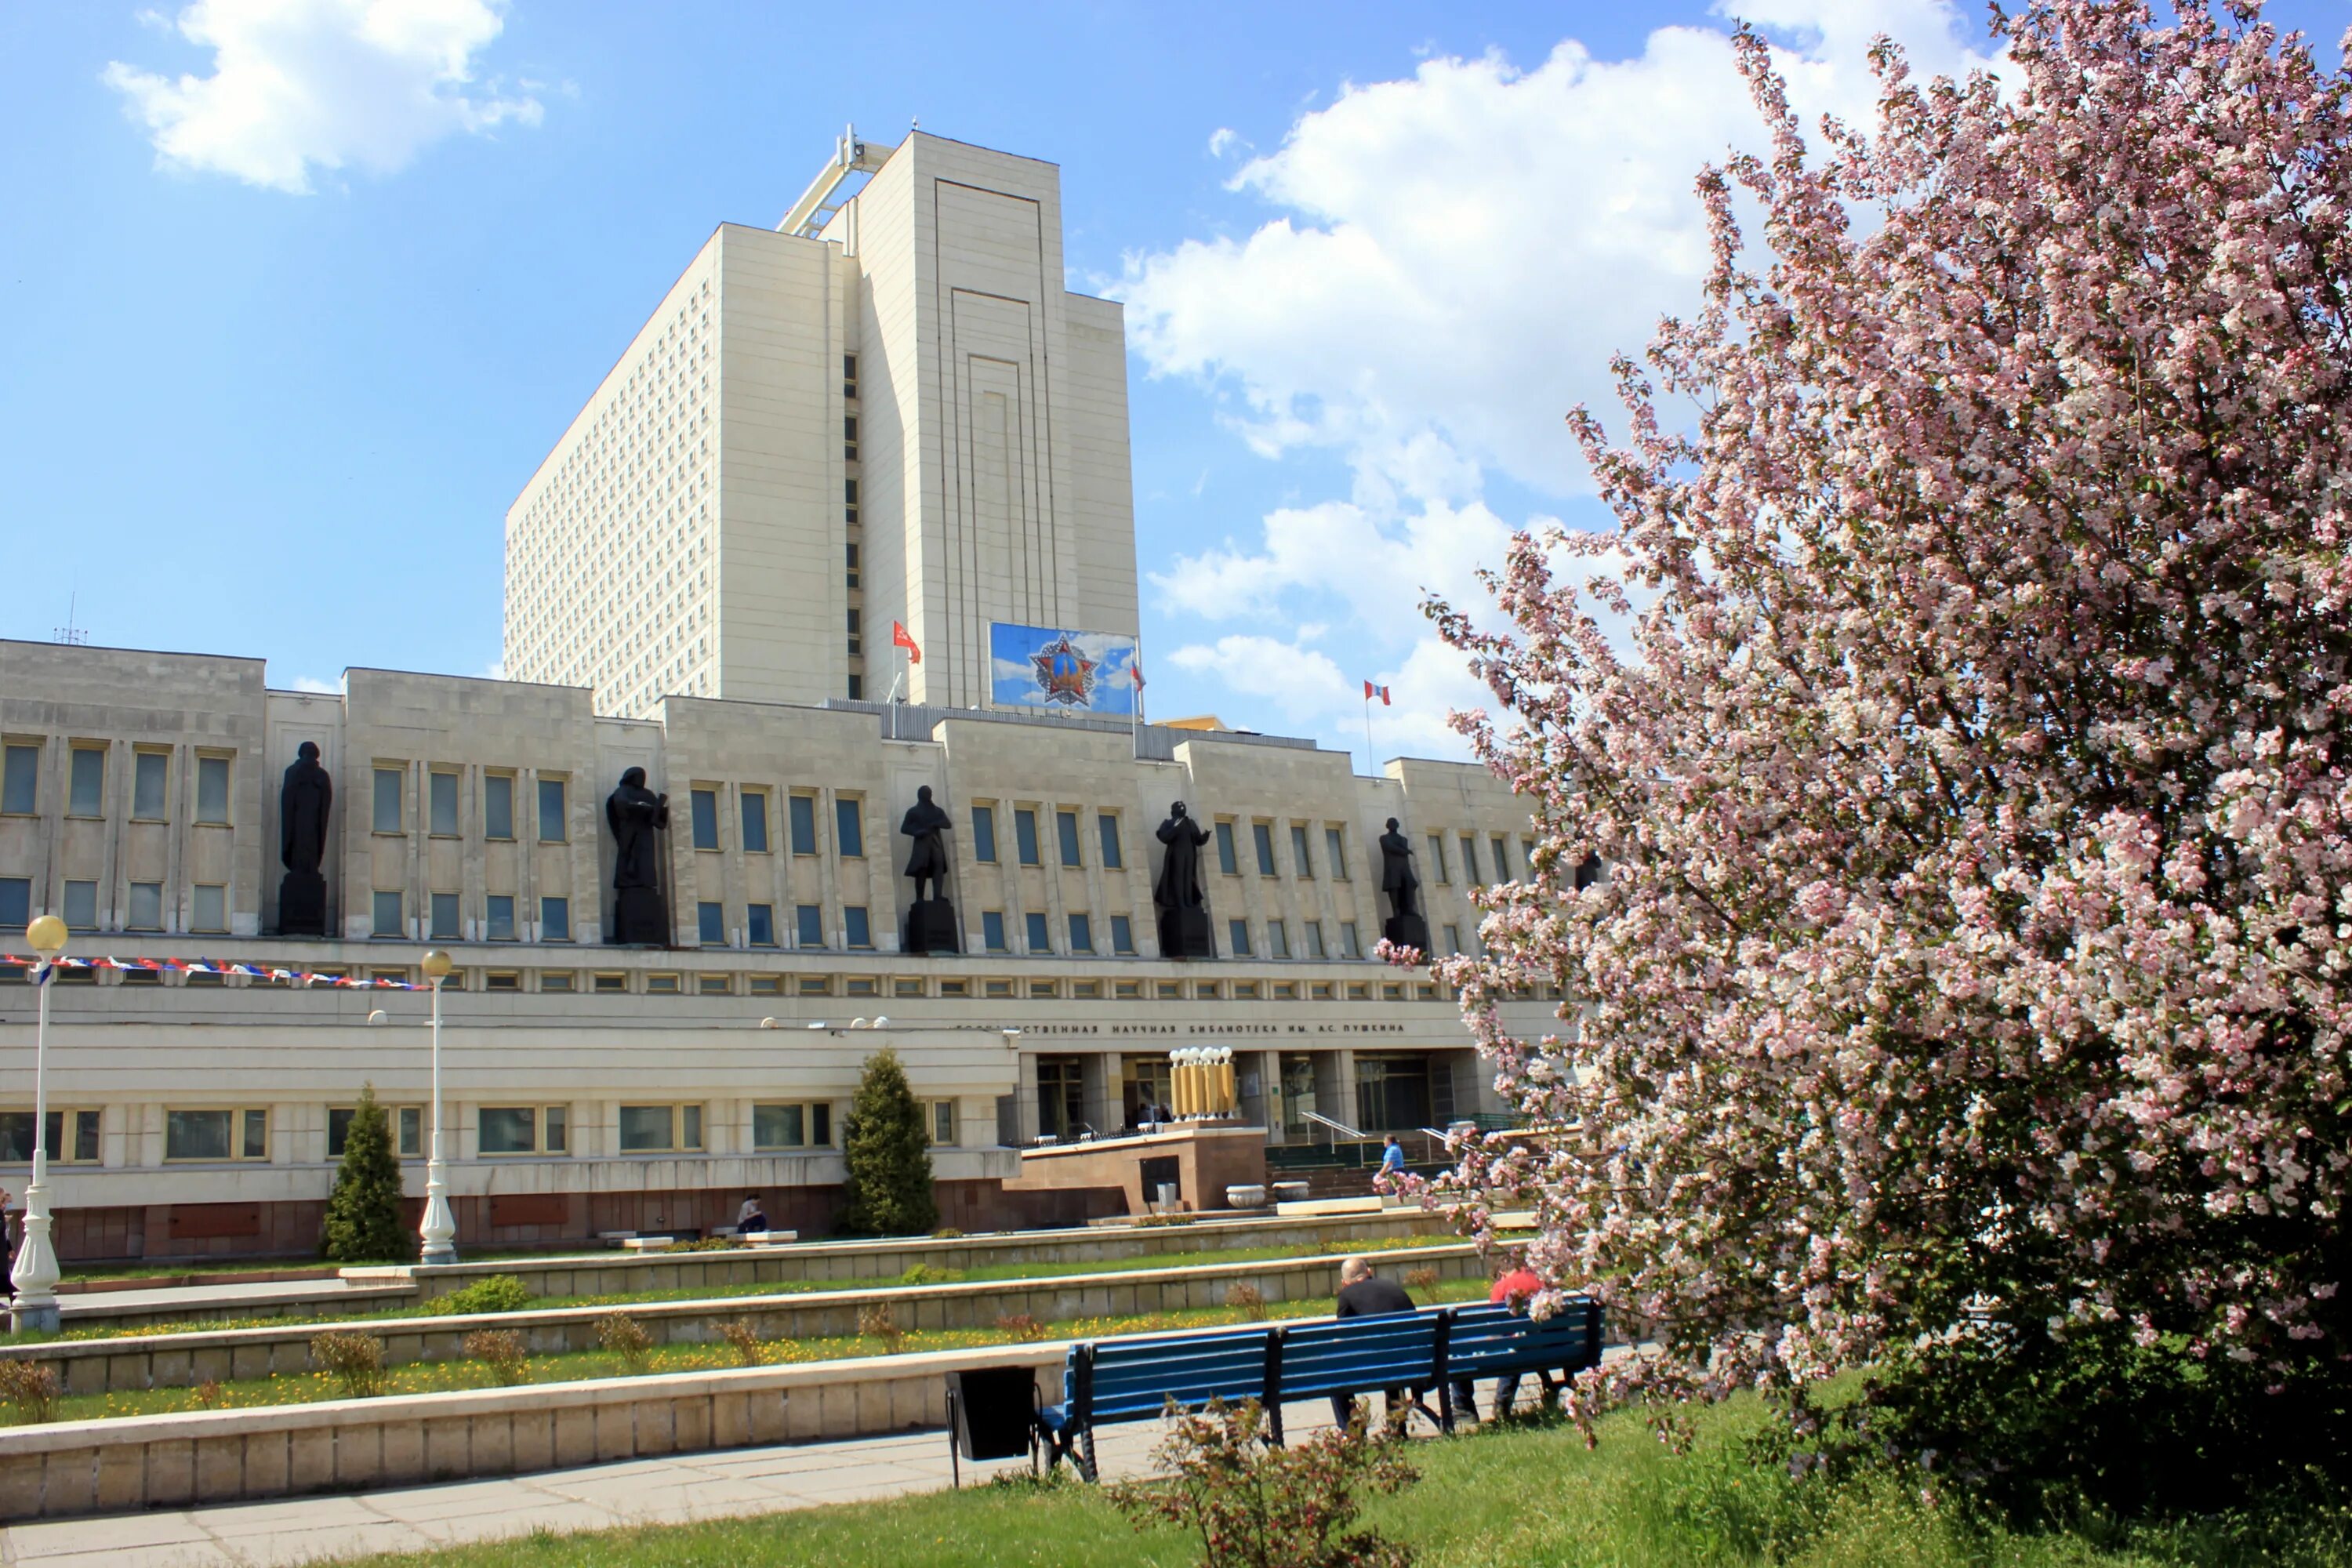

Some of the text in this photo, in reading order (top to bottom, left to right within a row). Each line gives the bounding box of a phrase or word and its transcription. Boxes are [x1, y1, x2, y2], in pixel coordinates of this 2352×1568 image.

[956, 1025, 1098, 1033] СТВЕННАЯ
[1112, 1025, 1176, 1033] НАУЧНАЯ
[1189, 1025, 1277, 1033] БИБЛИОТЕКА
